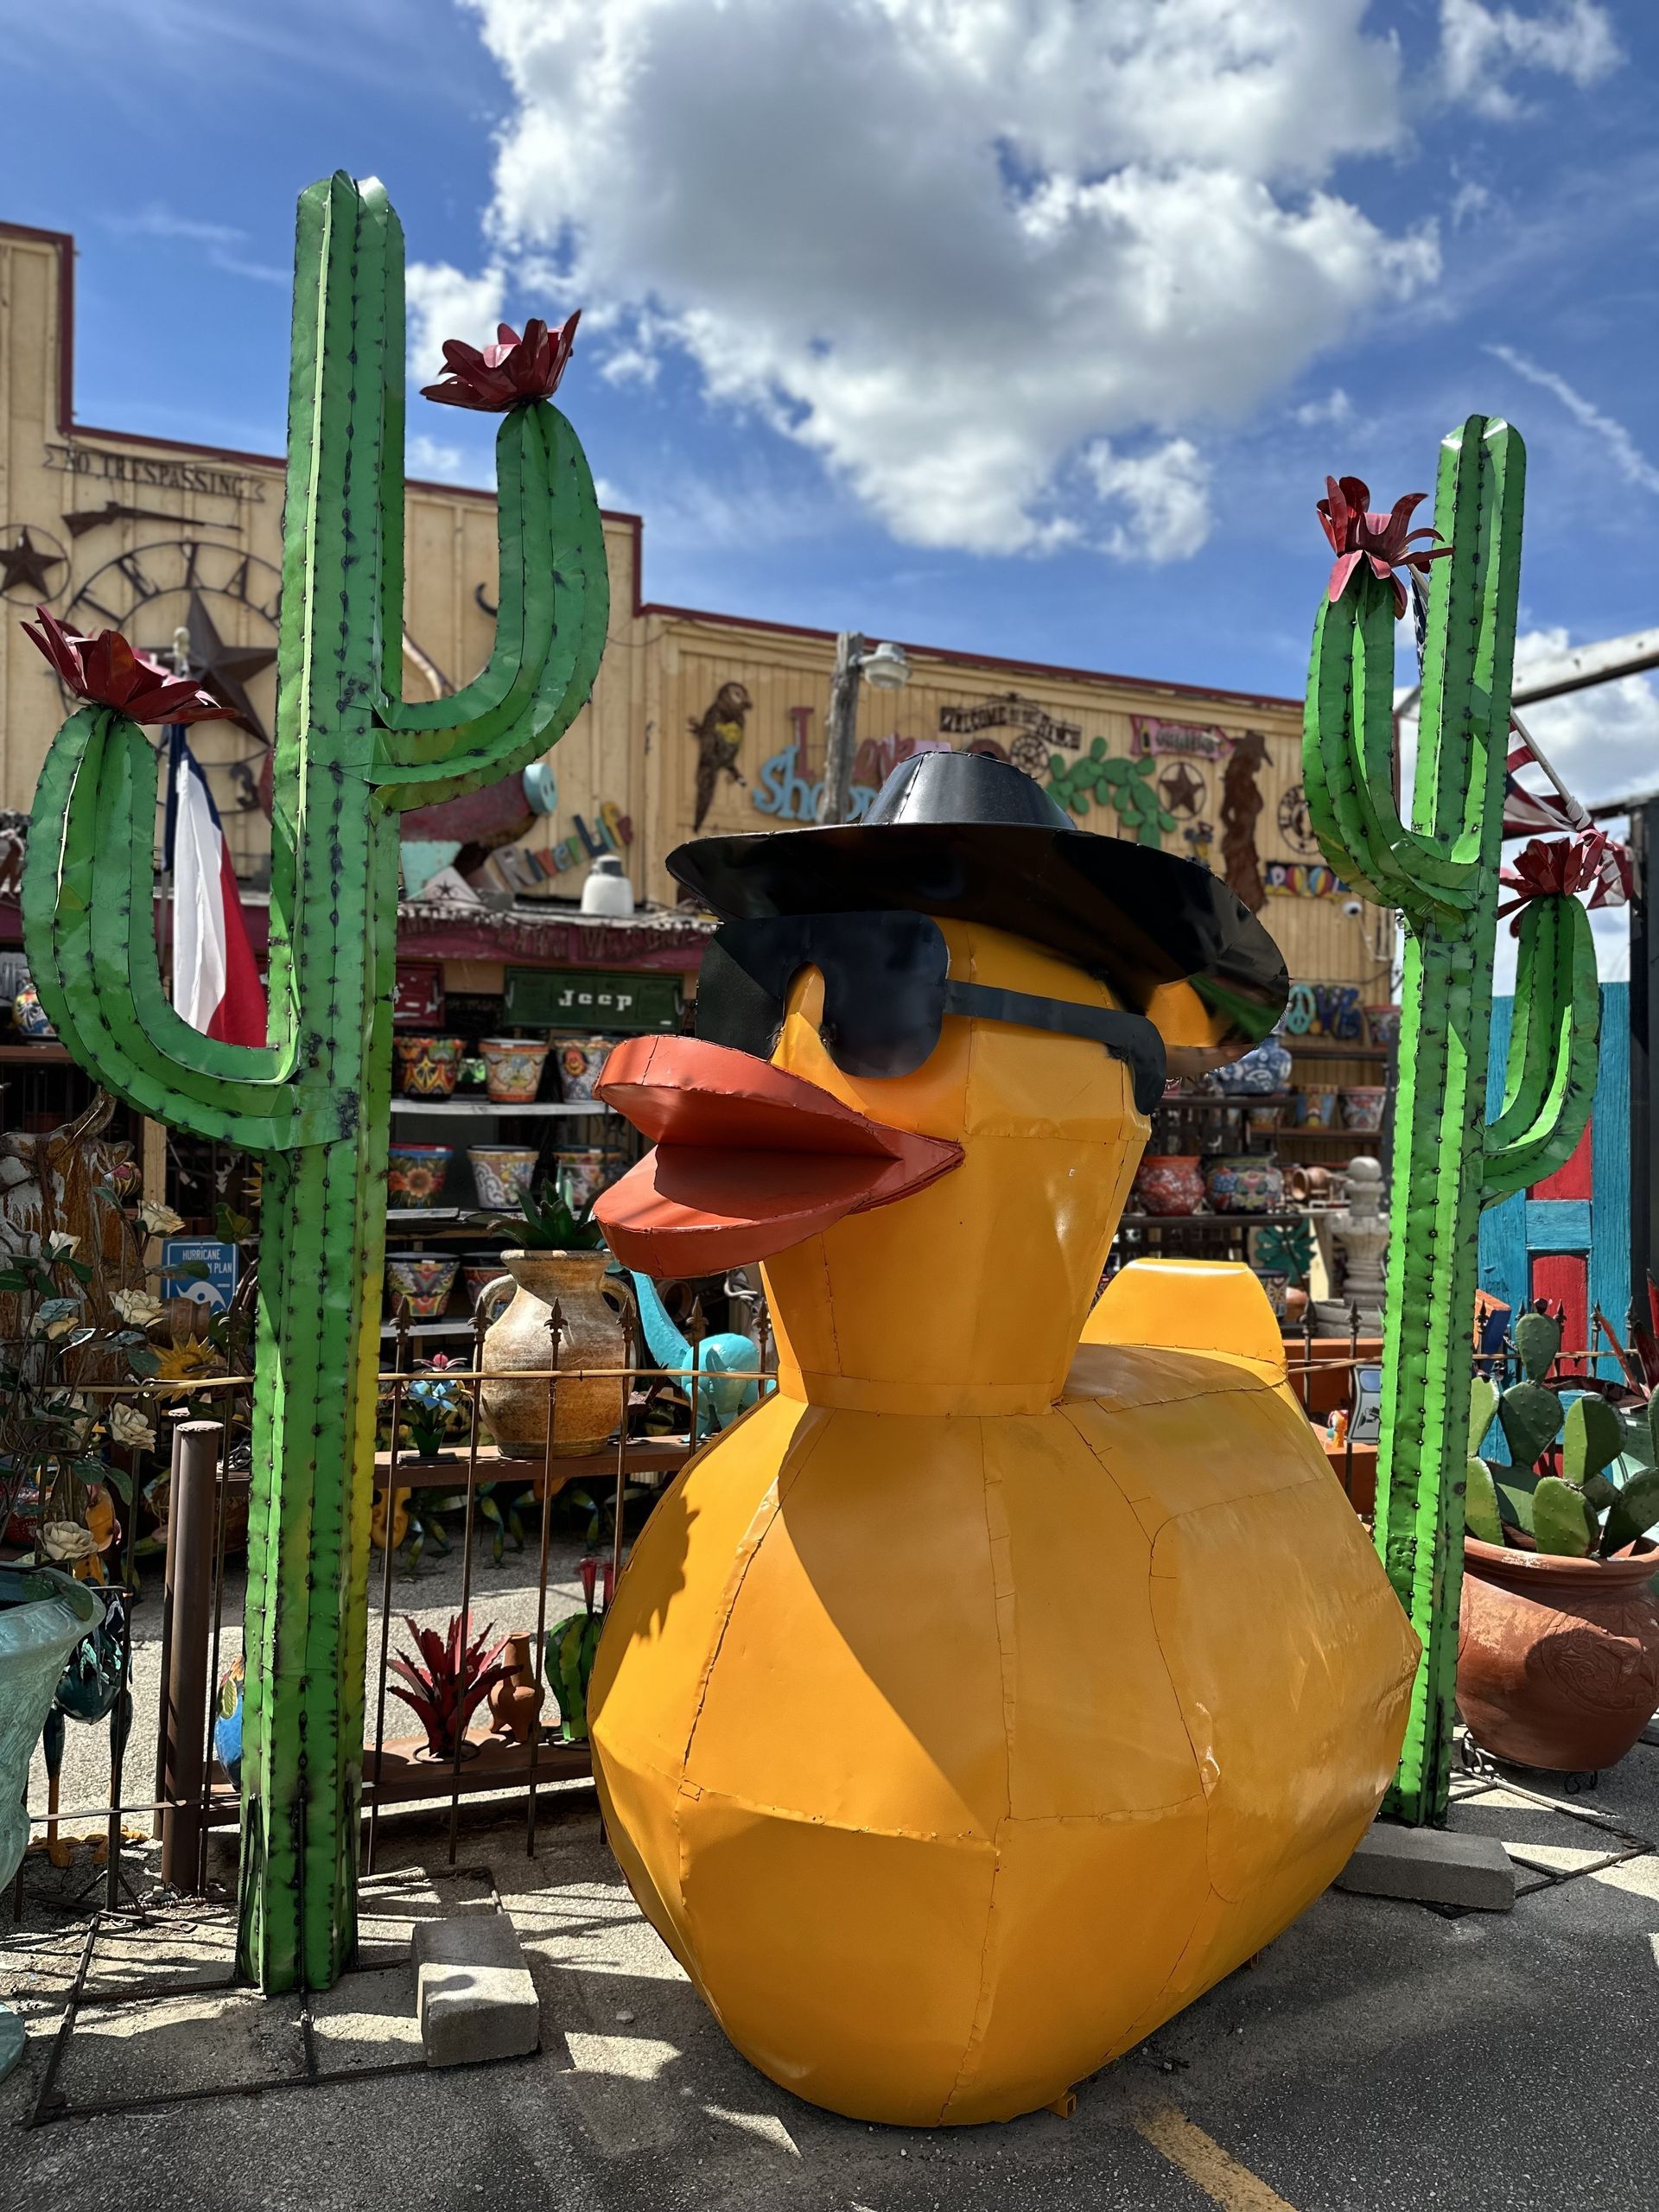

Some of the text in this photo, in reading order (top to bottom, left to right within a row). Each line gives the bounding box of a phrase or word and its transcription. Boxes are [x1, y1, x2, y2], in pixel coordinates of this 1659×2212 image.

[68, 449, 244, 499] NO TRESPASSING
[558, 989, 632, 1011] Jeep
[182, 1249, 221, 1261] HURRICANE
[213, 1262, 232, 1274] PLAN
